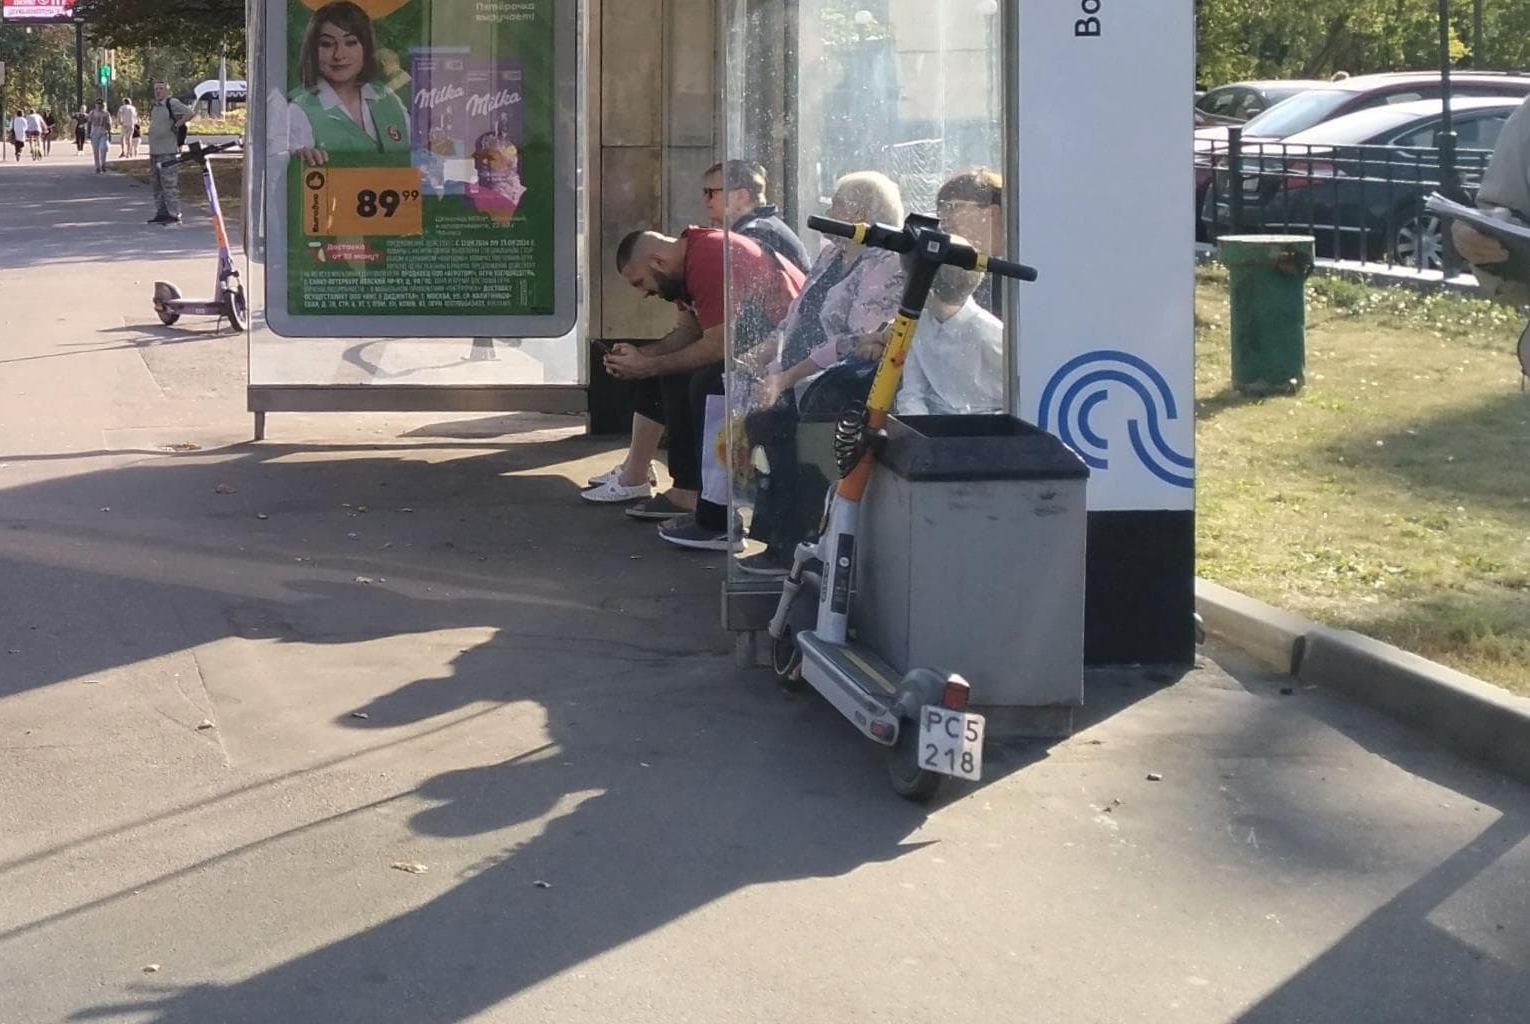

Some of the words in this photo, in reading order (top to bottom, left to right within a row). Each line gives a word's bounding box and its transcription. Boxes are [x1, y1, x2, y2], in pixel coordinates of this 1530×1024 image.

[414, 83, 465, 109] Milka
[465, 88, 522, 117] Milka
[356, 189, 401, 218] 89
[402, 189, 419, 202] 99
[924, 743, 975, 774] 218
